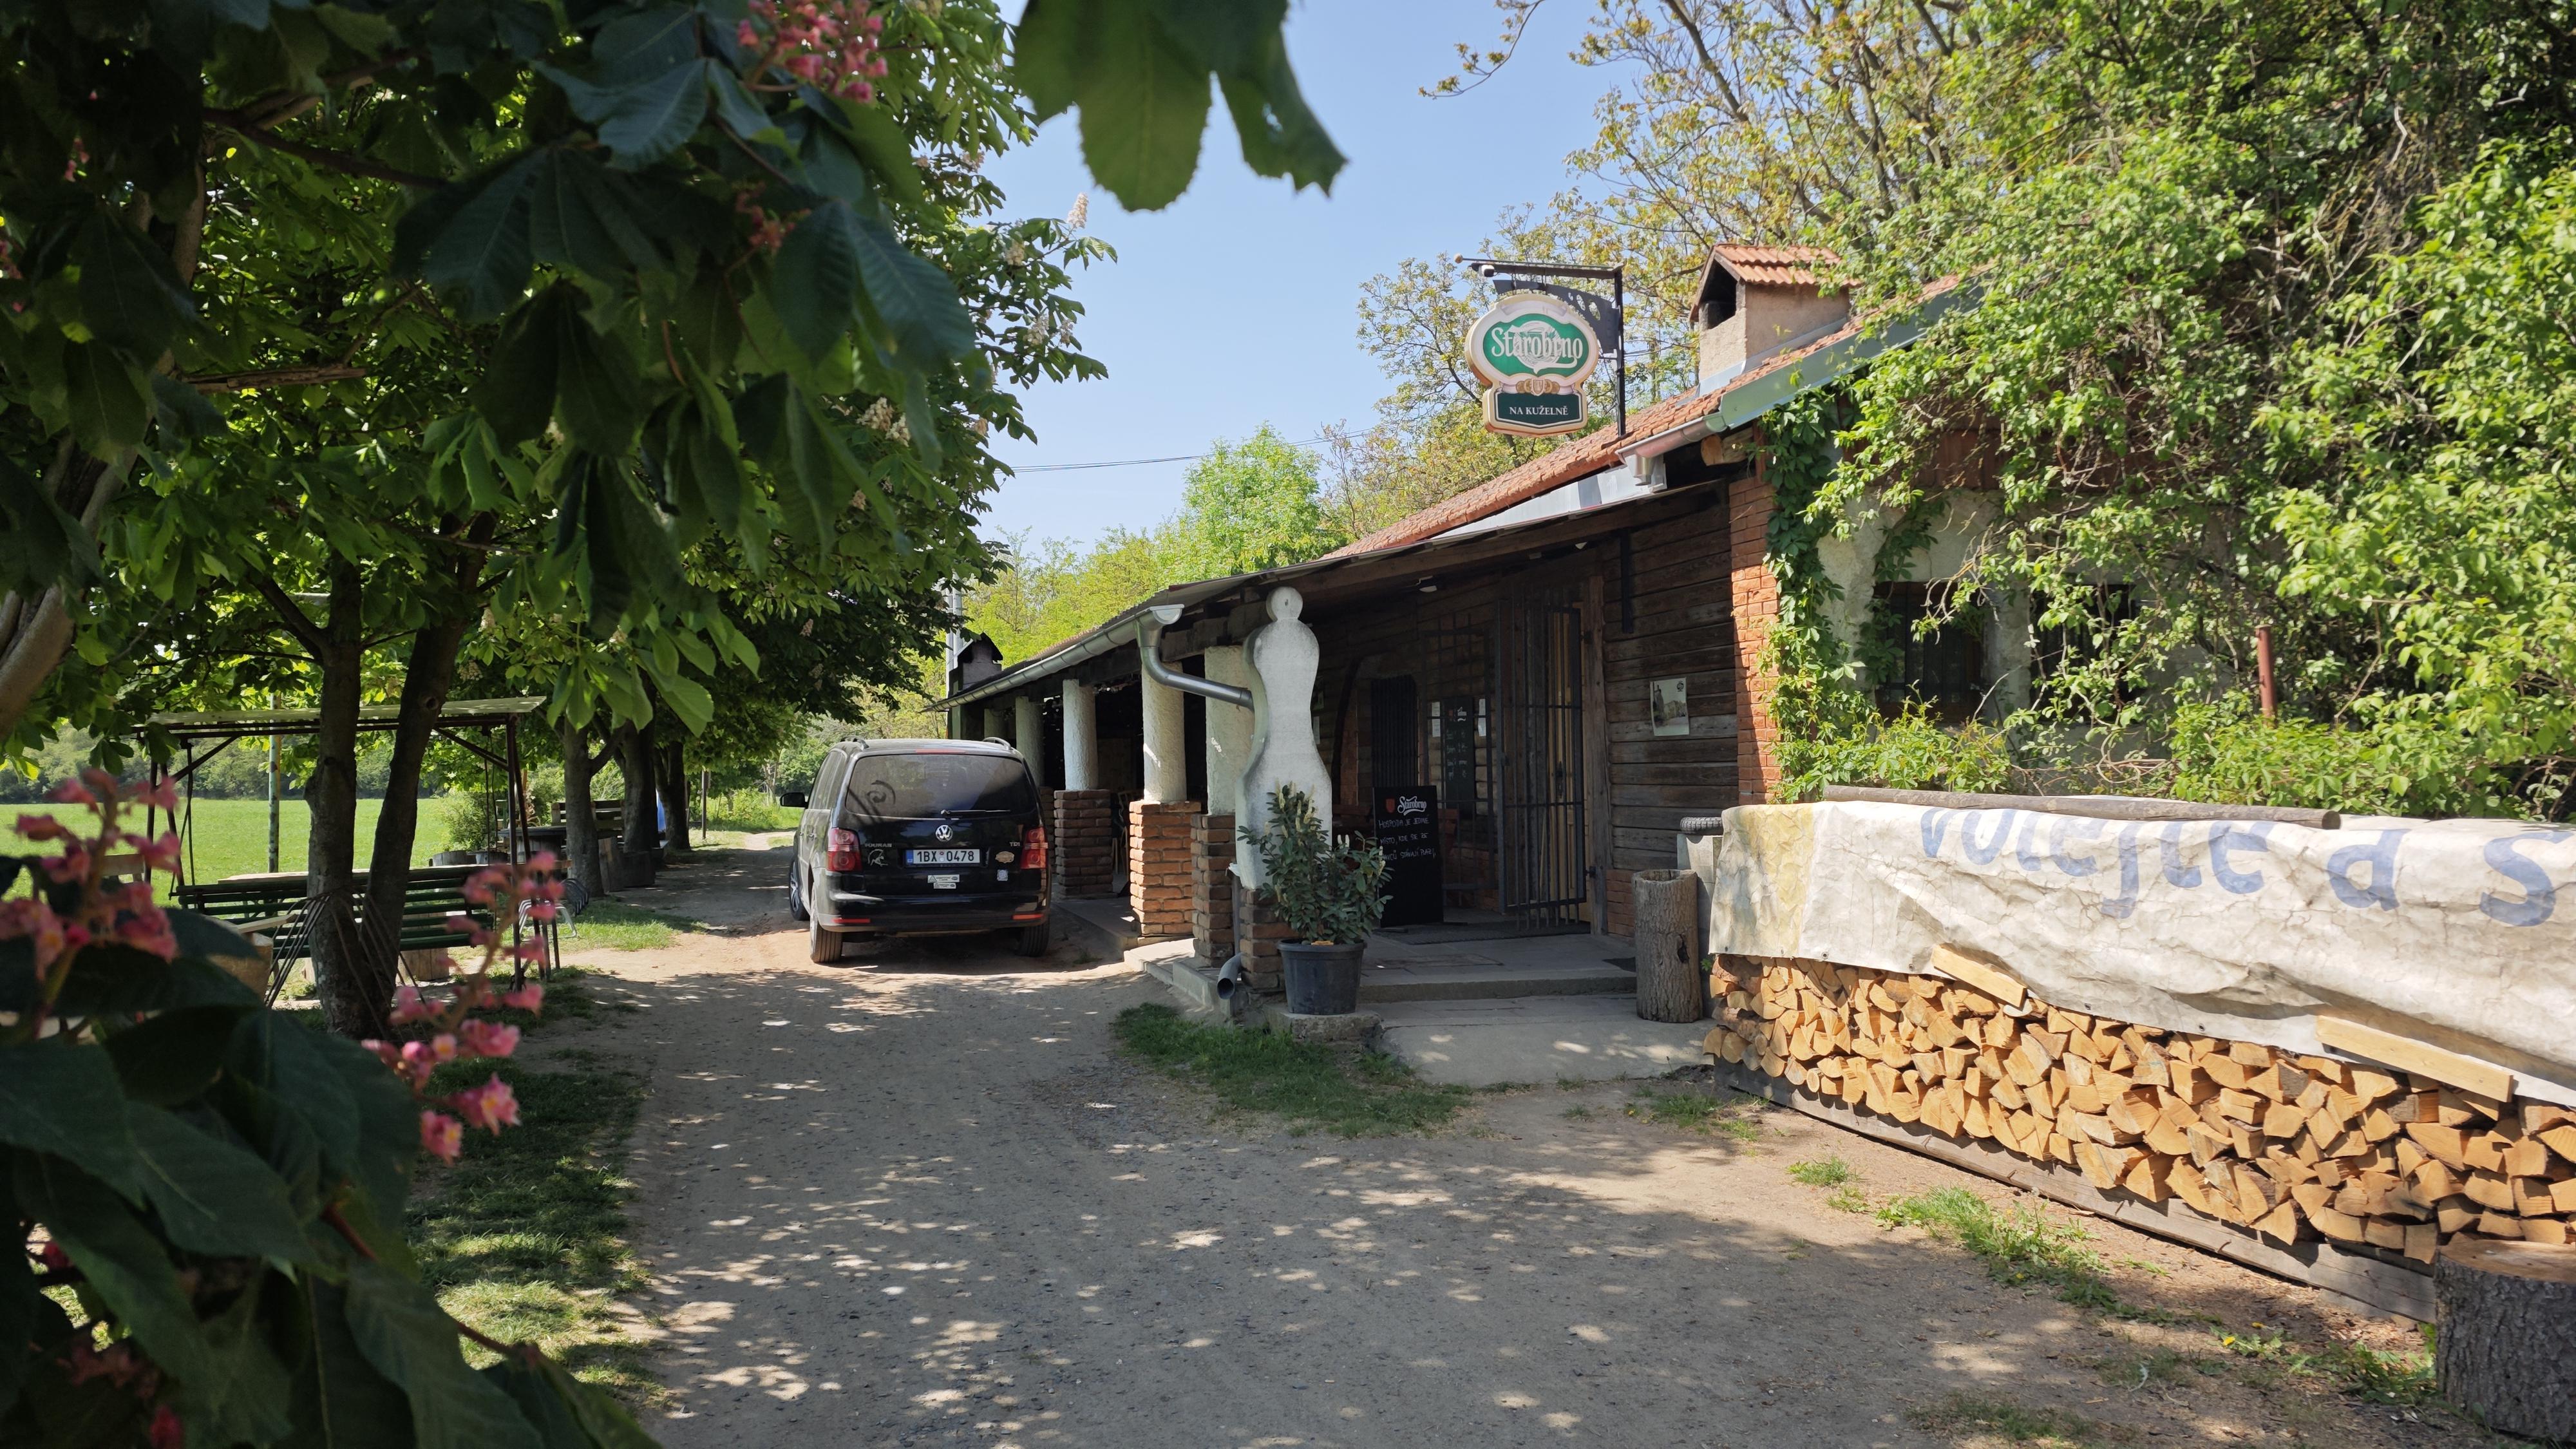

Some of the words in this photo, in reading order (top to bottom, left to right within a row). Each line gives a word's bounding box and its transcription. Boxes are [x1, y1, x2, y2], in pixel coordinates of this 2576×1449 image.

[1491, 325, 1583, 372] Starobrno
[1510, 406, 1523, 415] NA
[1526, 406, 1568, 415] KUŽELNĚ
[1397, 795, 1427, 816] Starobrno
[917, 851, 937, 862] 1BX
[946, 850, 974, 862] 0478
